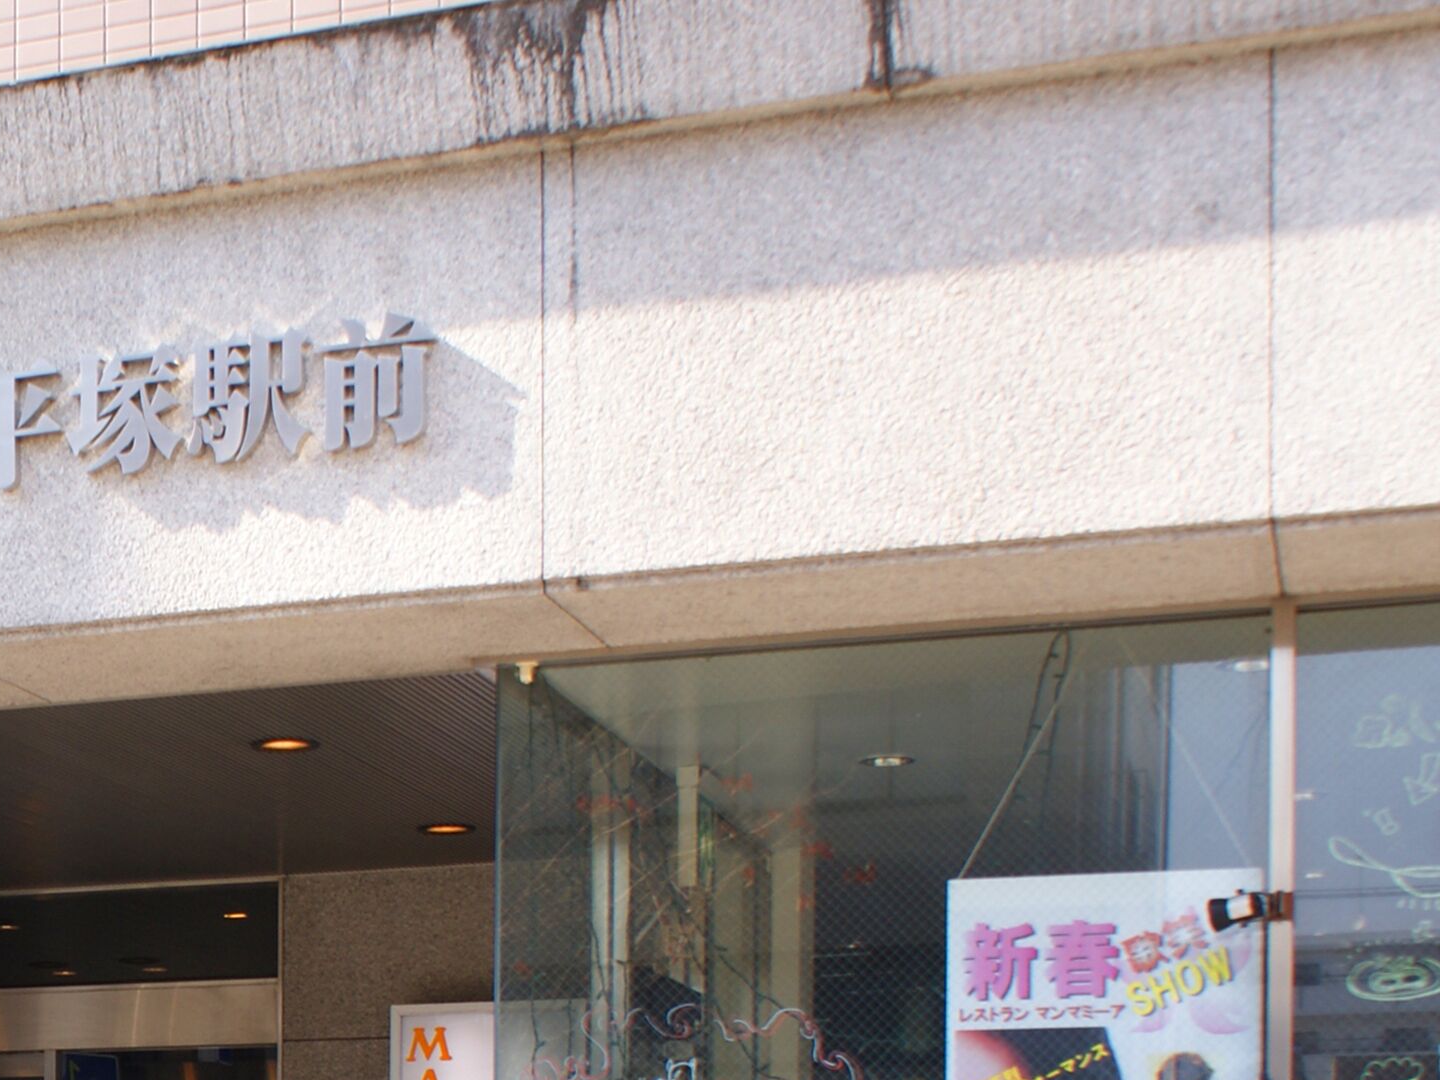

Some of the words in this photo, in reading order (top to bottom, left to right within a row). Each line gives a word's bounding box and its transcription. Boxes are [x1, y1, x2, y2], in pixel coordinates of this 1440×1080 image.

[963, 919, 1120, 1001] 新春
[1126, 945, 1233, 1017] SHOW
[959, 1004, 1030, 1023] レストラン
[1035, 1003, 1126, 1021] マンマミーア
